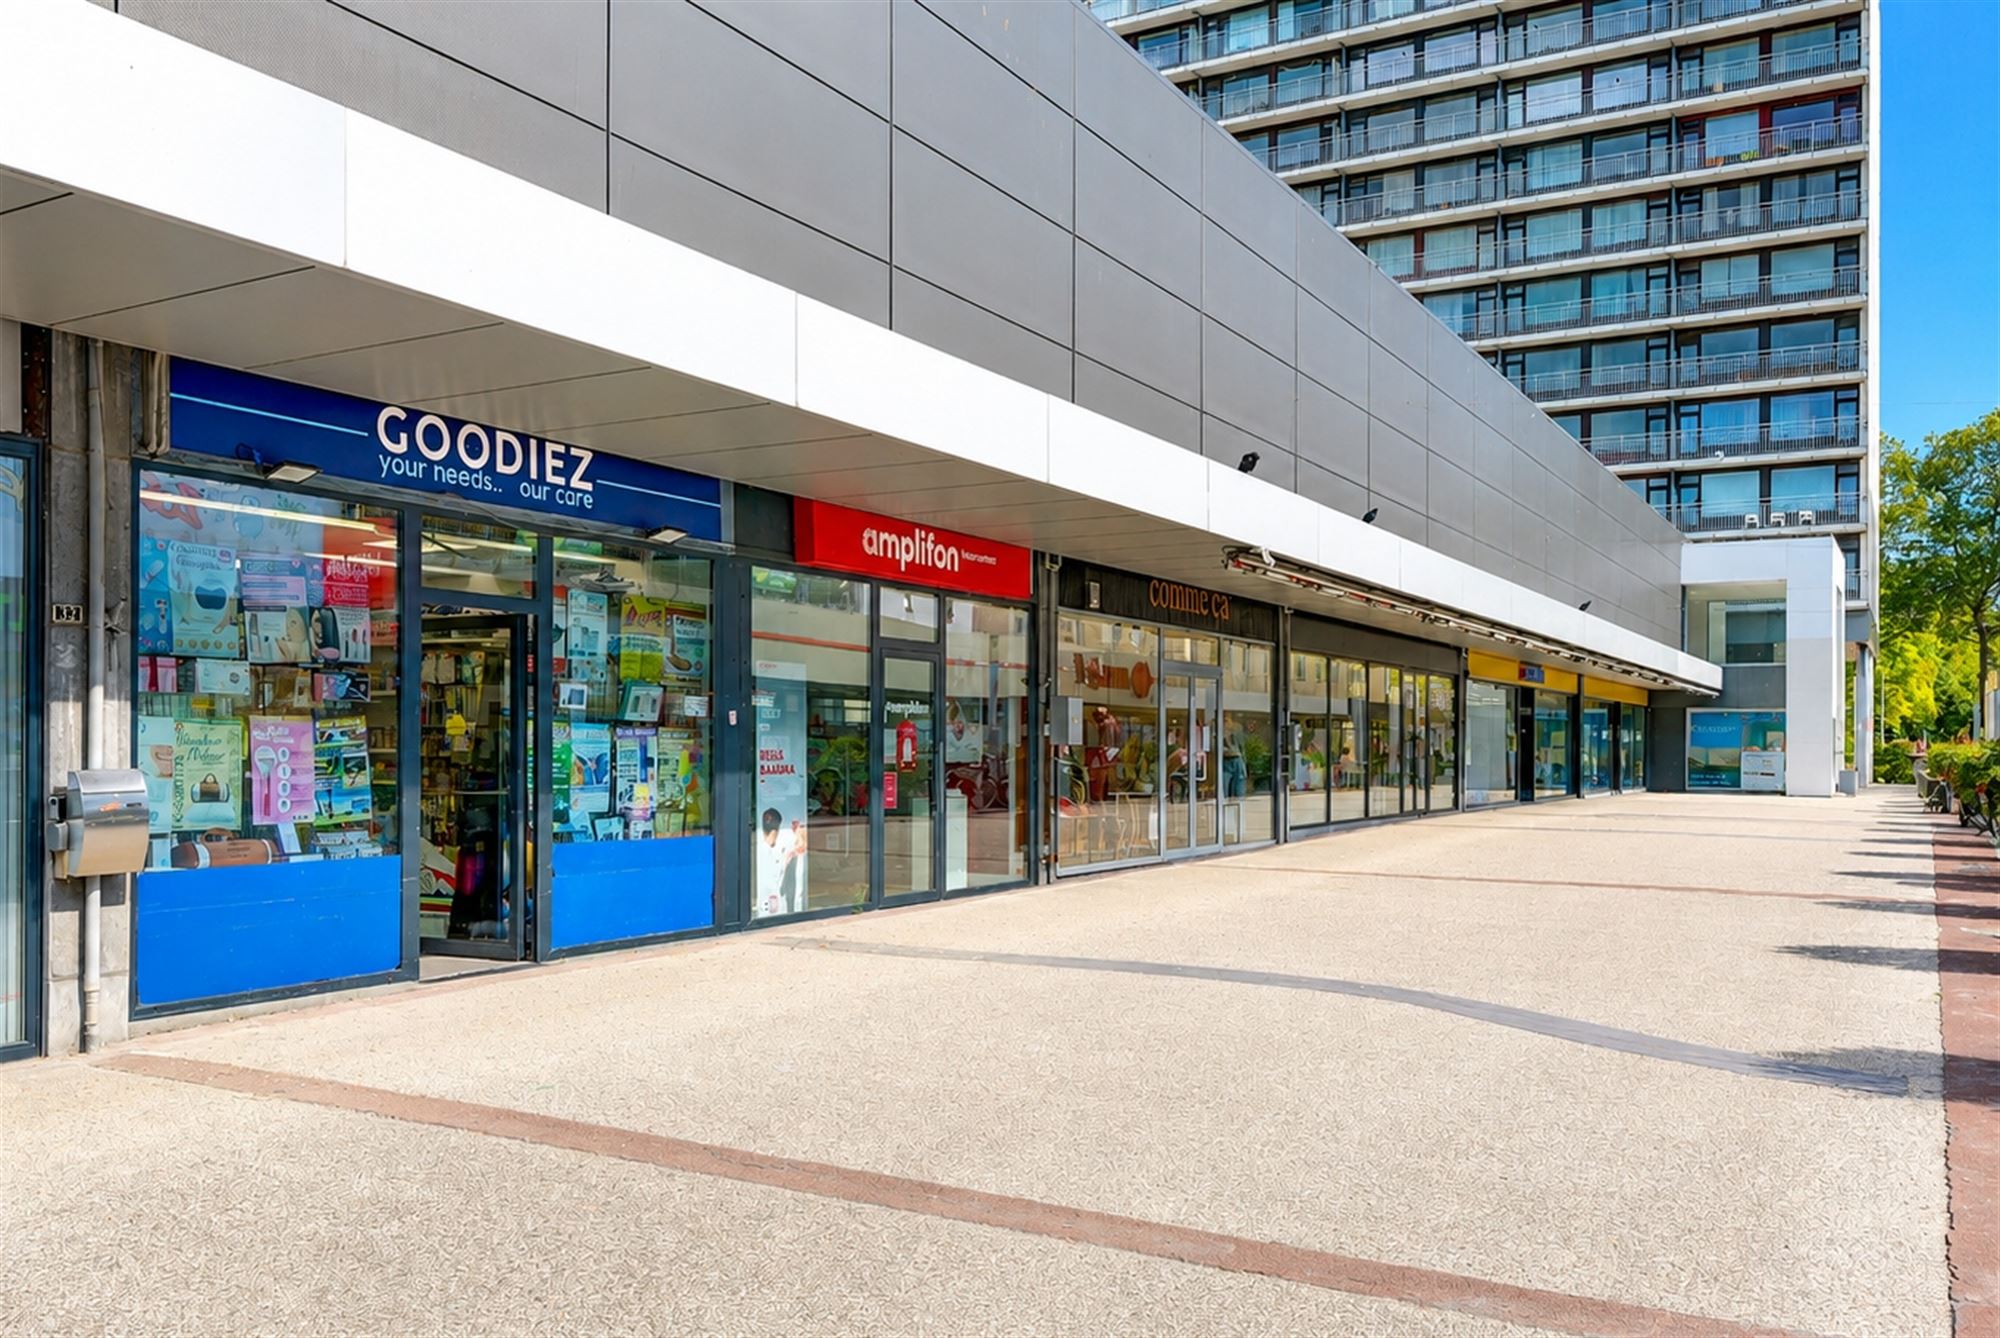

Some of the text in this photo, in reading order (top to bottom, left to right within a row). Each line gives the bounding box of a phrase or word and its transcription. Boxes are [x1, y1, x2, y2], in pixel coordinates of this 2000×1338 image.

[377, 406, 593, 490] GOODIEZ
[379, 454, 427, 478] your
[520, 483, 551, 501] our
[556, 489, 593, 509] care
[862, 527, 959, 572] amplifon
[1149, 579, 1209, 616] comme
